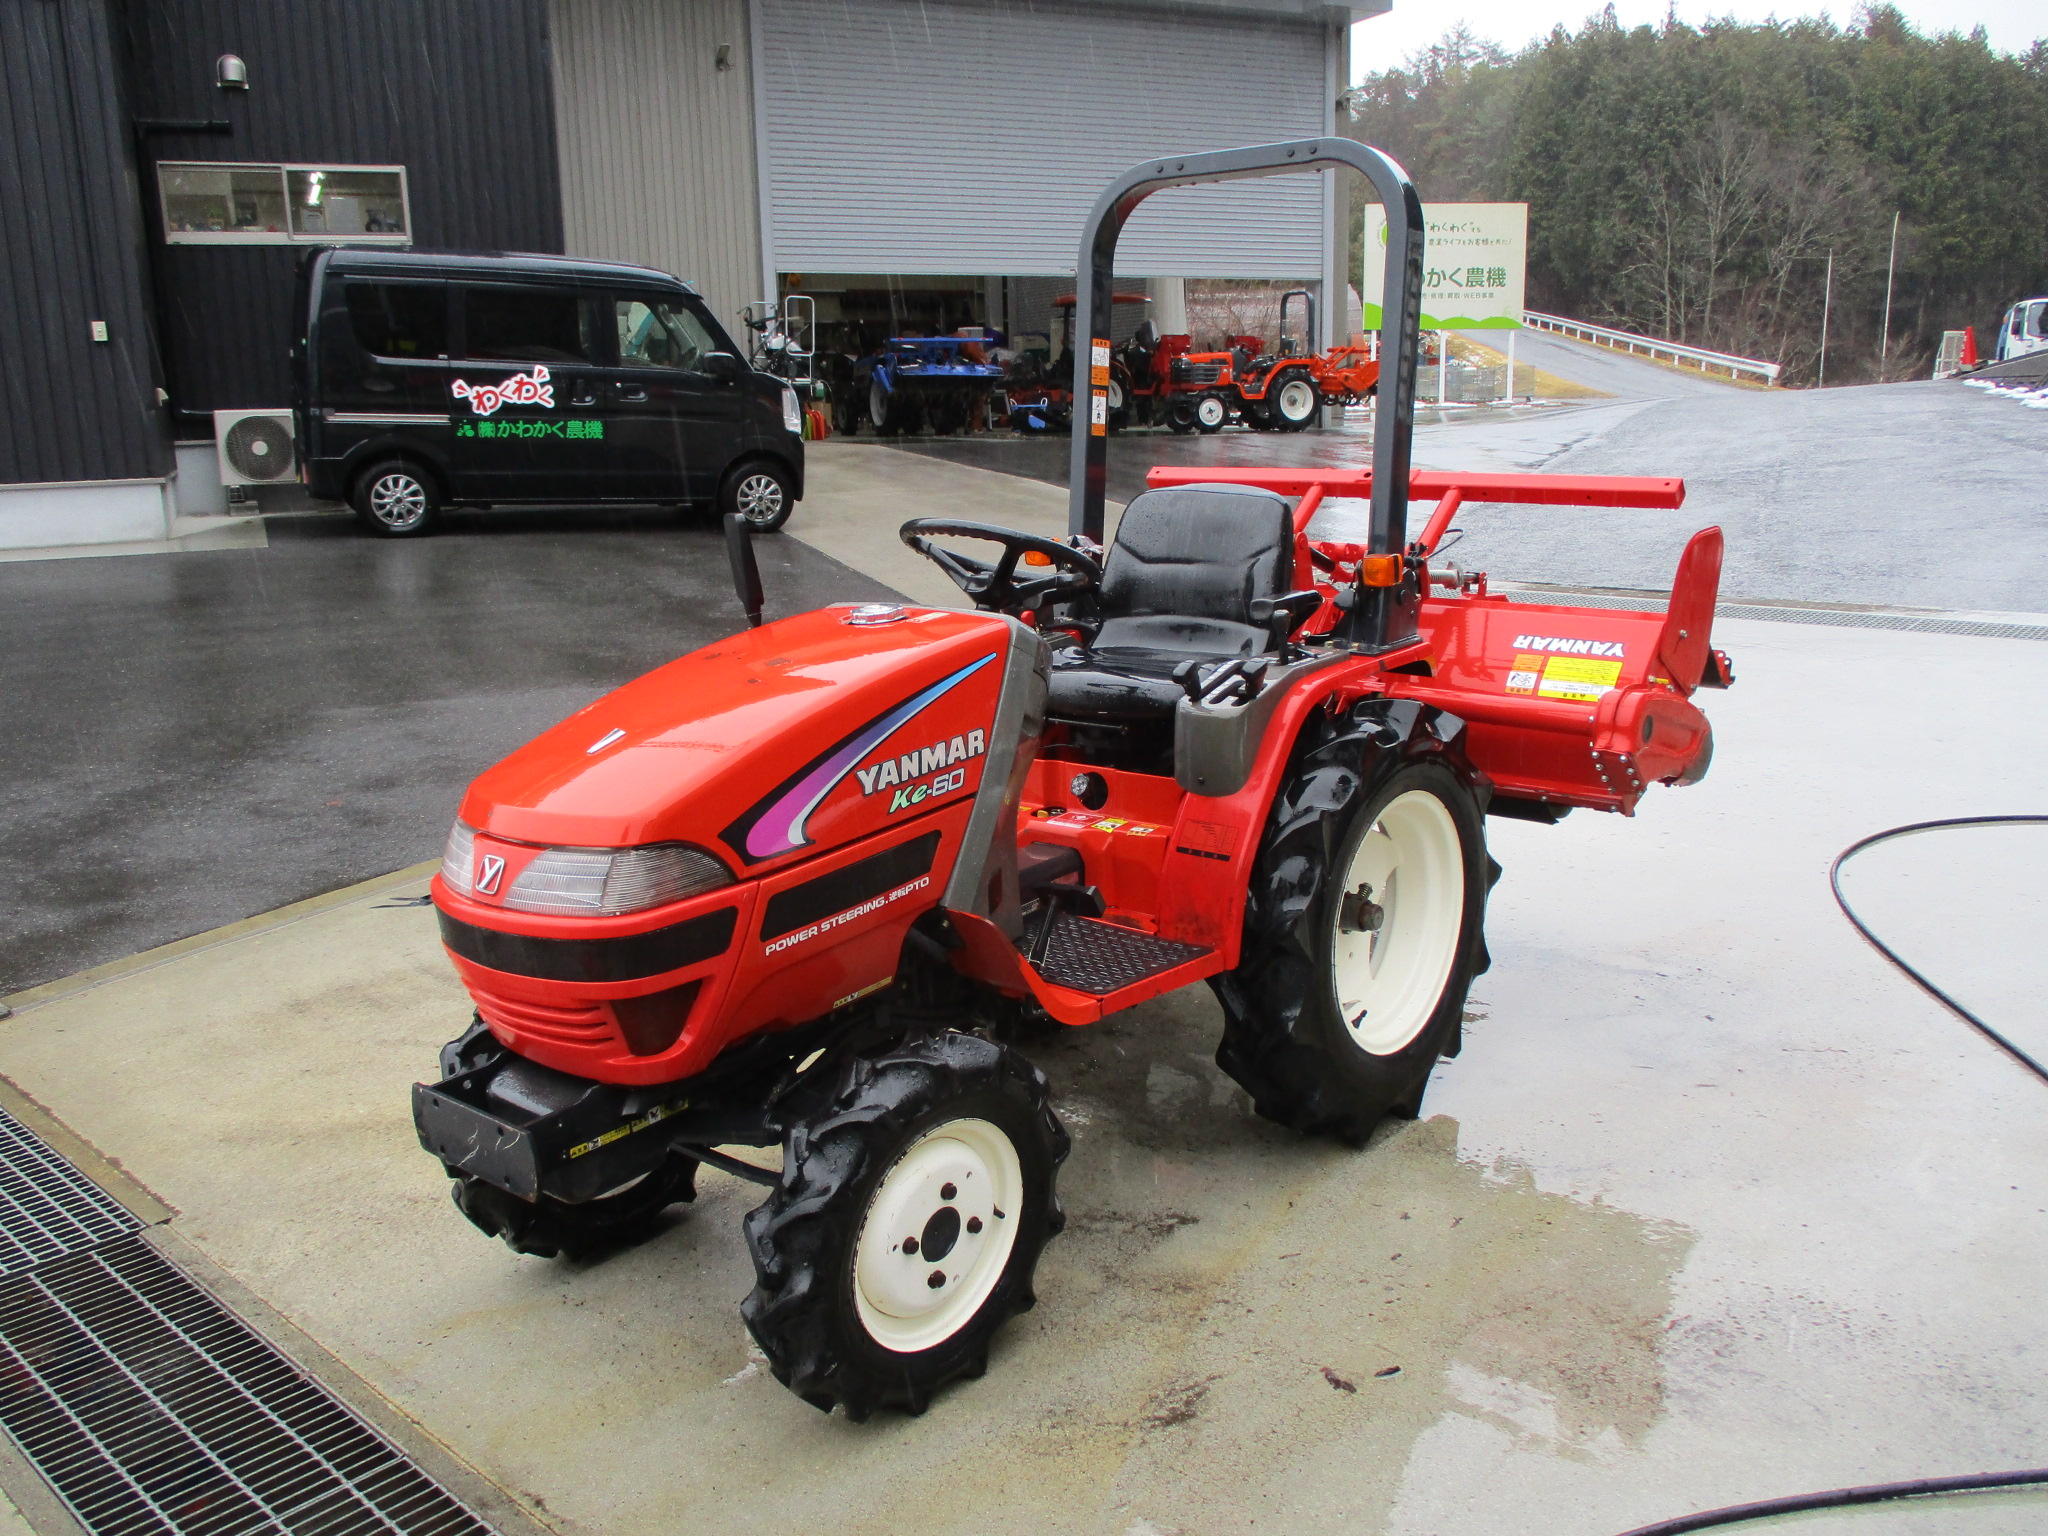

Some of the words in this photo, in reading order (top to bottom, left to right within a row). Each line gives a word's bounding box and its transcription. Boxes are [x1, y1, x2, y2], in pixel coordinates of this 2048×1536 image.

[1421, 266, 1507, 288] かく農機
[471, 374, 554, 414] わくわく
[1512, 634, 1625, 658] YANMAR
[855, 728, 986, 797] YANMAR
[887, 767, 966, 816] Ke-60
[765, 921, 818, 957] POWER
